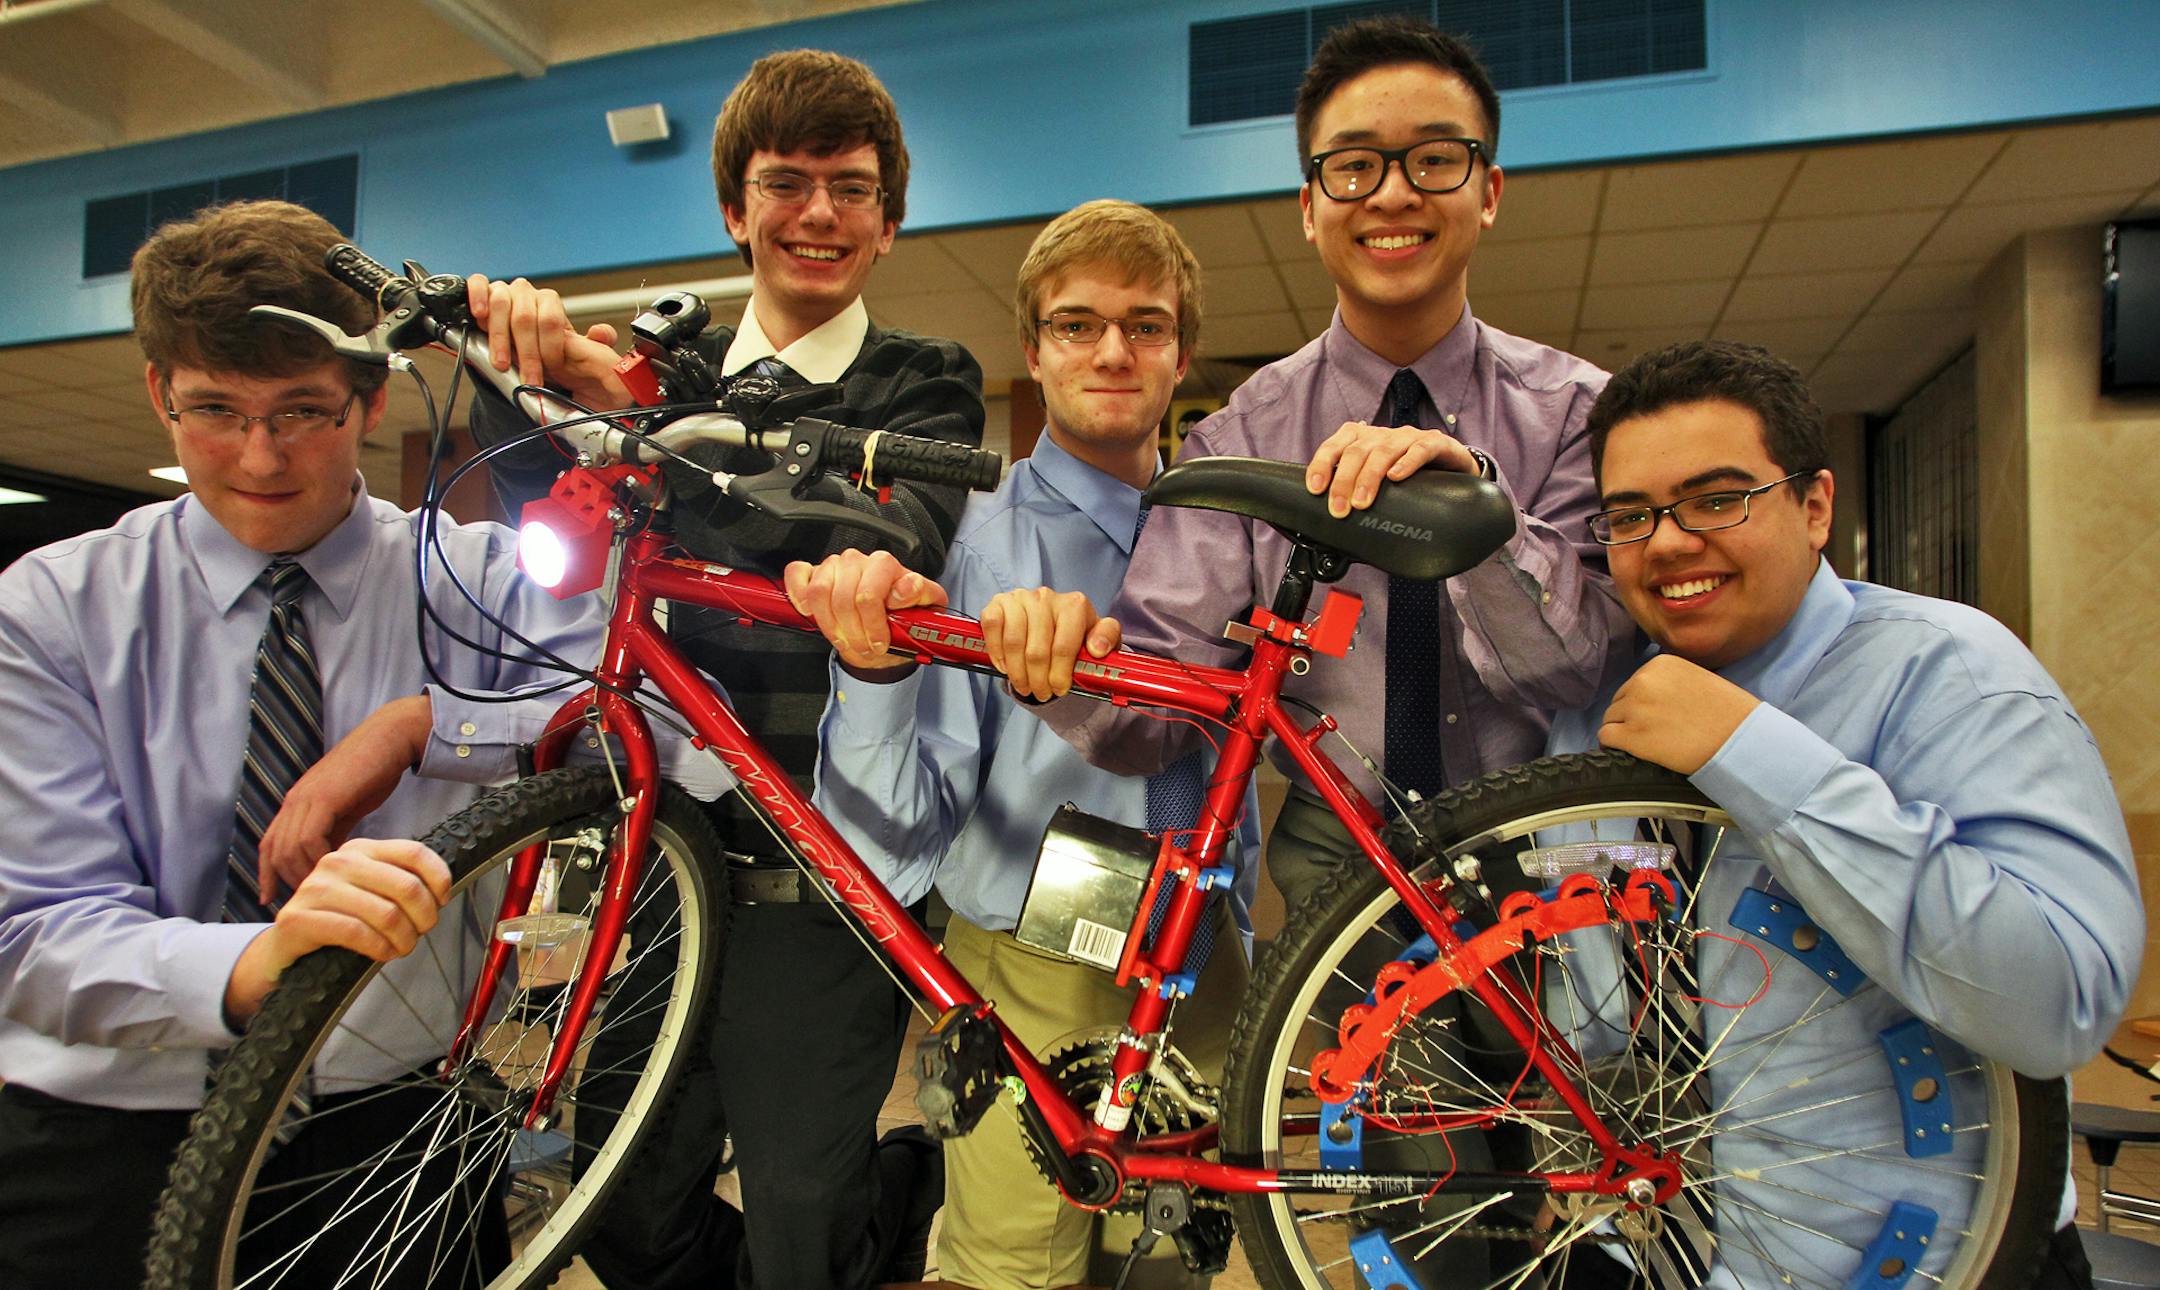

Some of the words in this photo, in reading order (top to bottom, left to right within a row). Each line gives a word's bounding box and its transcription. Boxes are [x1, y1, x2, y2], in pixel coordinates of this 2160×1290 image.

[1360, 515, 1433, 542] MAGNA
[909, 625, 992, 653] GLAC
[1073, 660, 1126, 681] INT
[709, 745, 898, 943] MAGNA
[1312, 1173, 1372, 1189] INDEX
